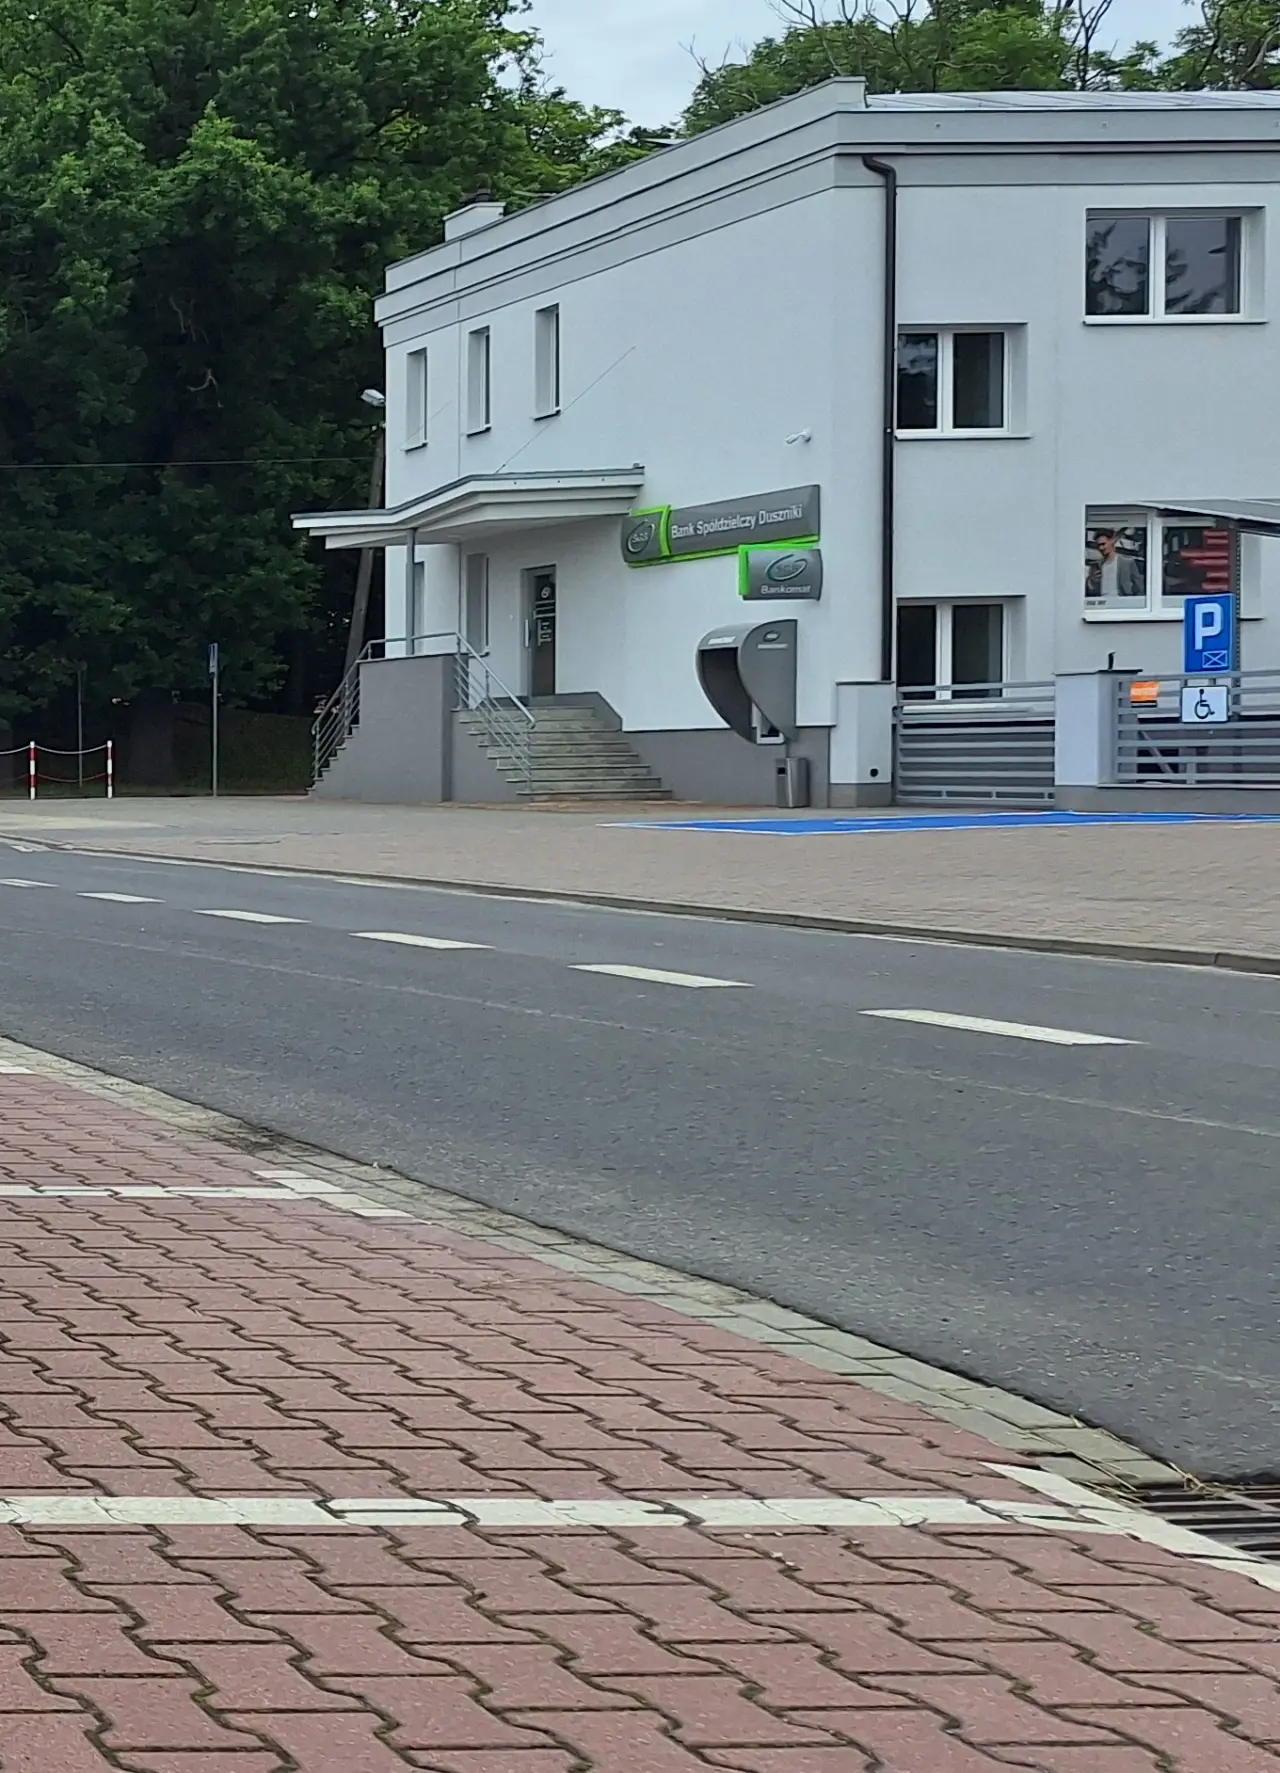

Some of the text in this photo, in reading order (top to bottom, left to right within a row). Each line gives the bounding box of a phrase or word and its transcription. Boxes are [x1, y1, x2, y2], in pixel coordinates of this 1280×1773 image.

[670, 522, 695, 539] Bank
[758, 504, 803, 525] Duszniki
[1194, 603, 1223, 650] P
